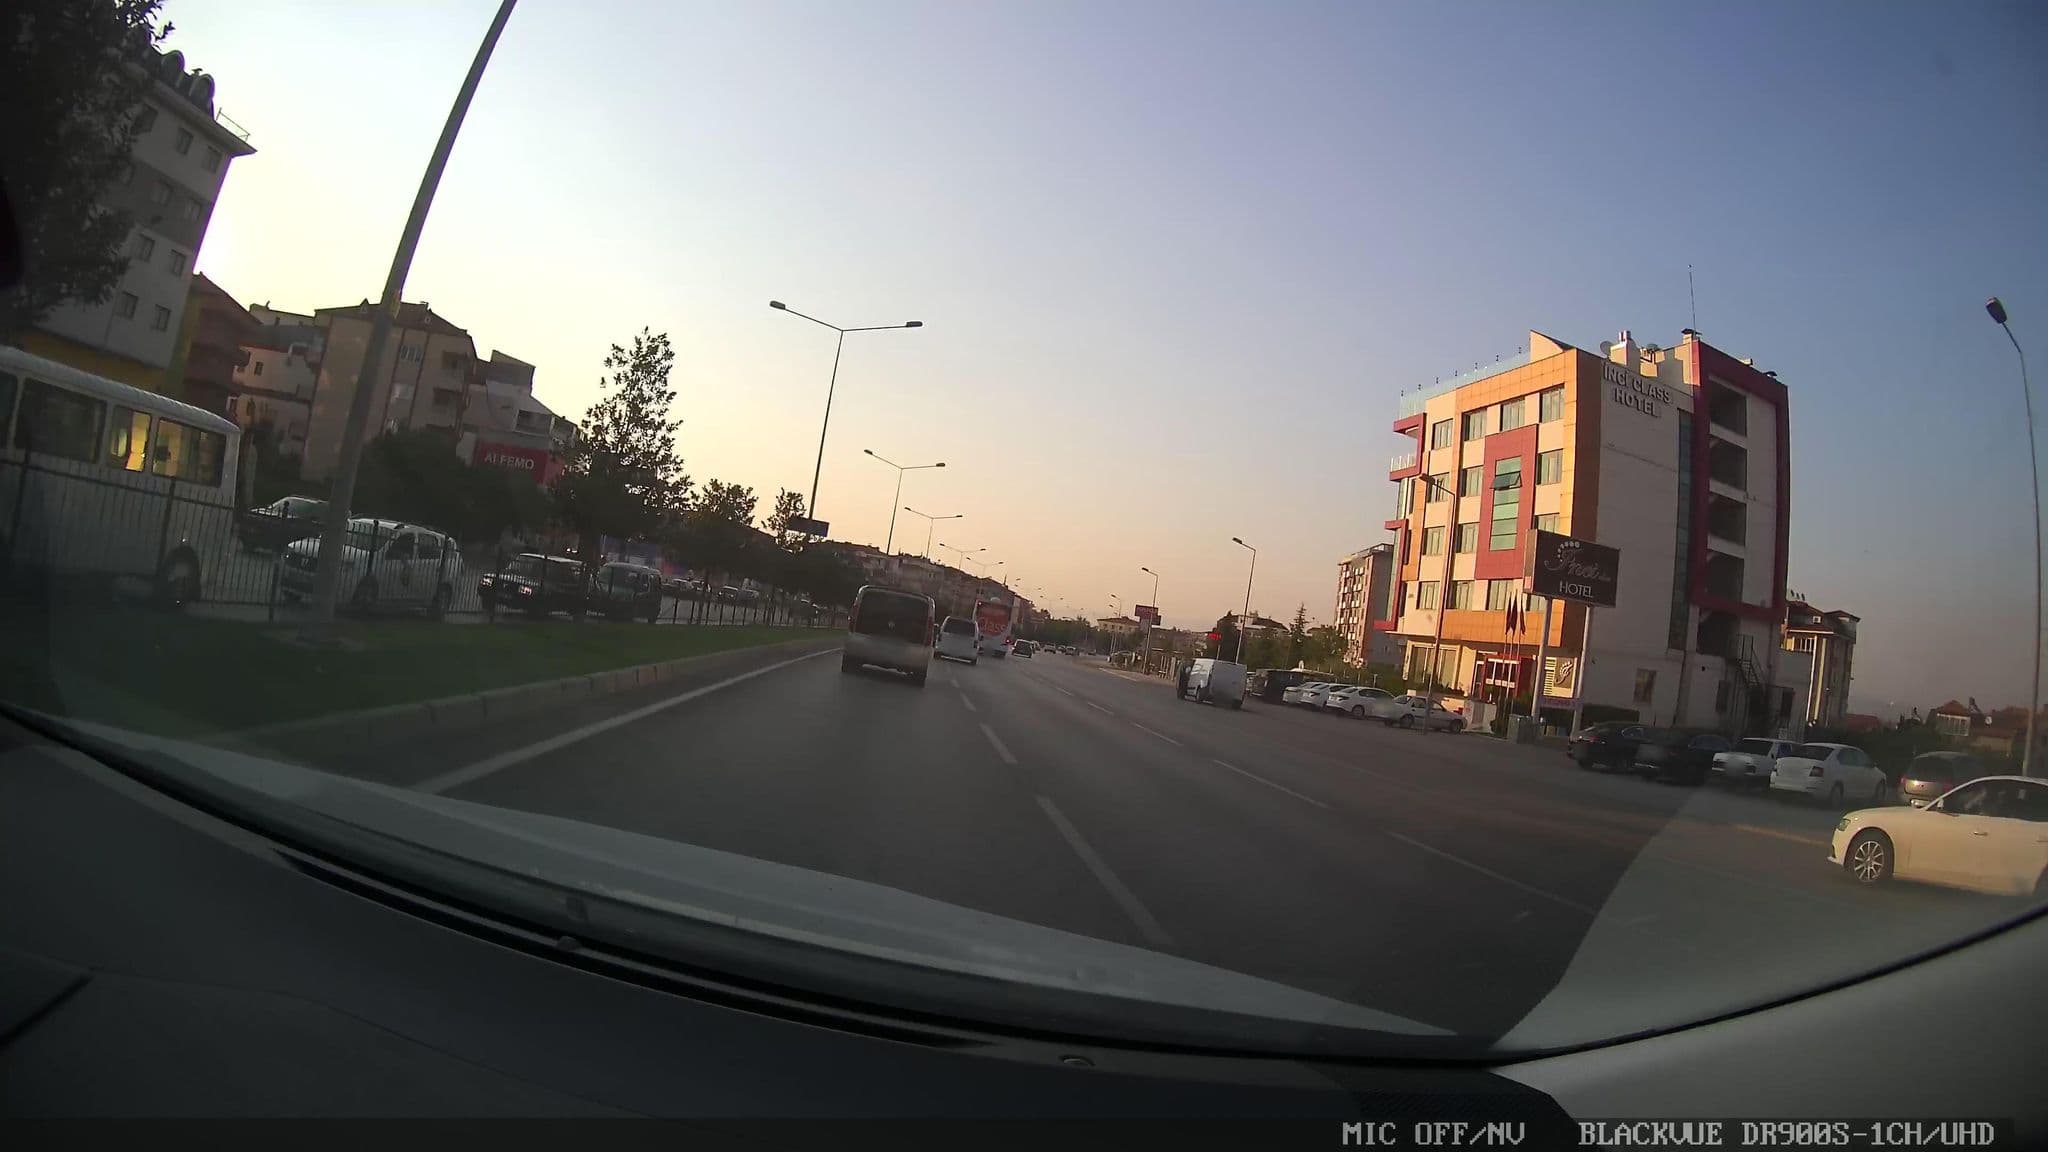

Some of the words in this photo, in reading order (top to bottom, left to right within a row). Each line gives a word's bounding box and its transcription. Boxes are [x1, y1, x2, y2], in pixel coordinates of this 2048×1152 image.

[1615, 387, 1658, 417] HOTEL
[1632, 378, 1671, 405] CLASS
[1560, 580, 1593, 598] HOTEL
